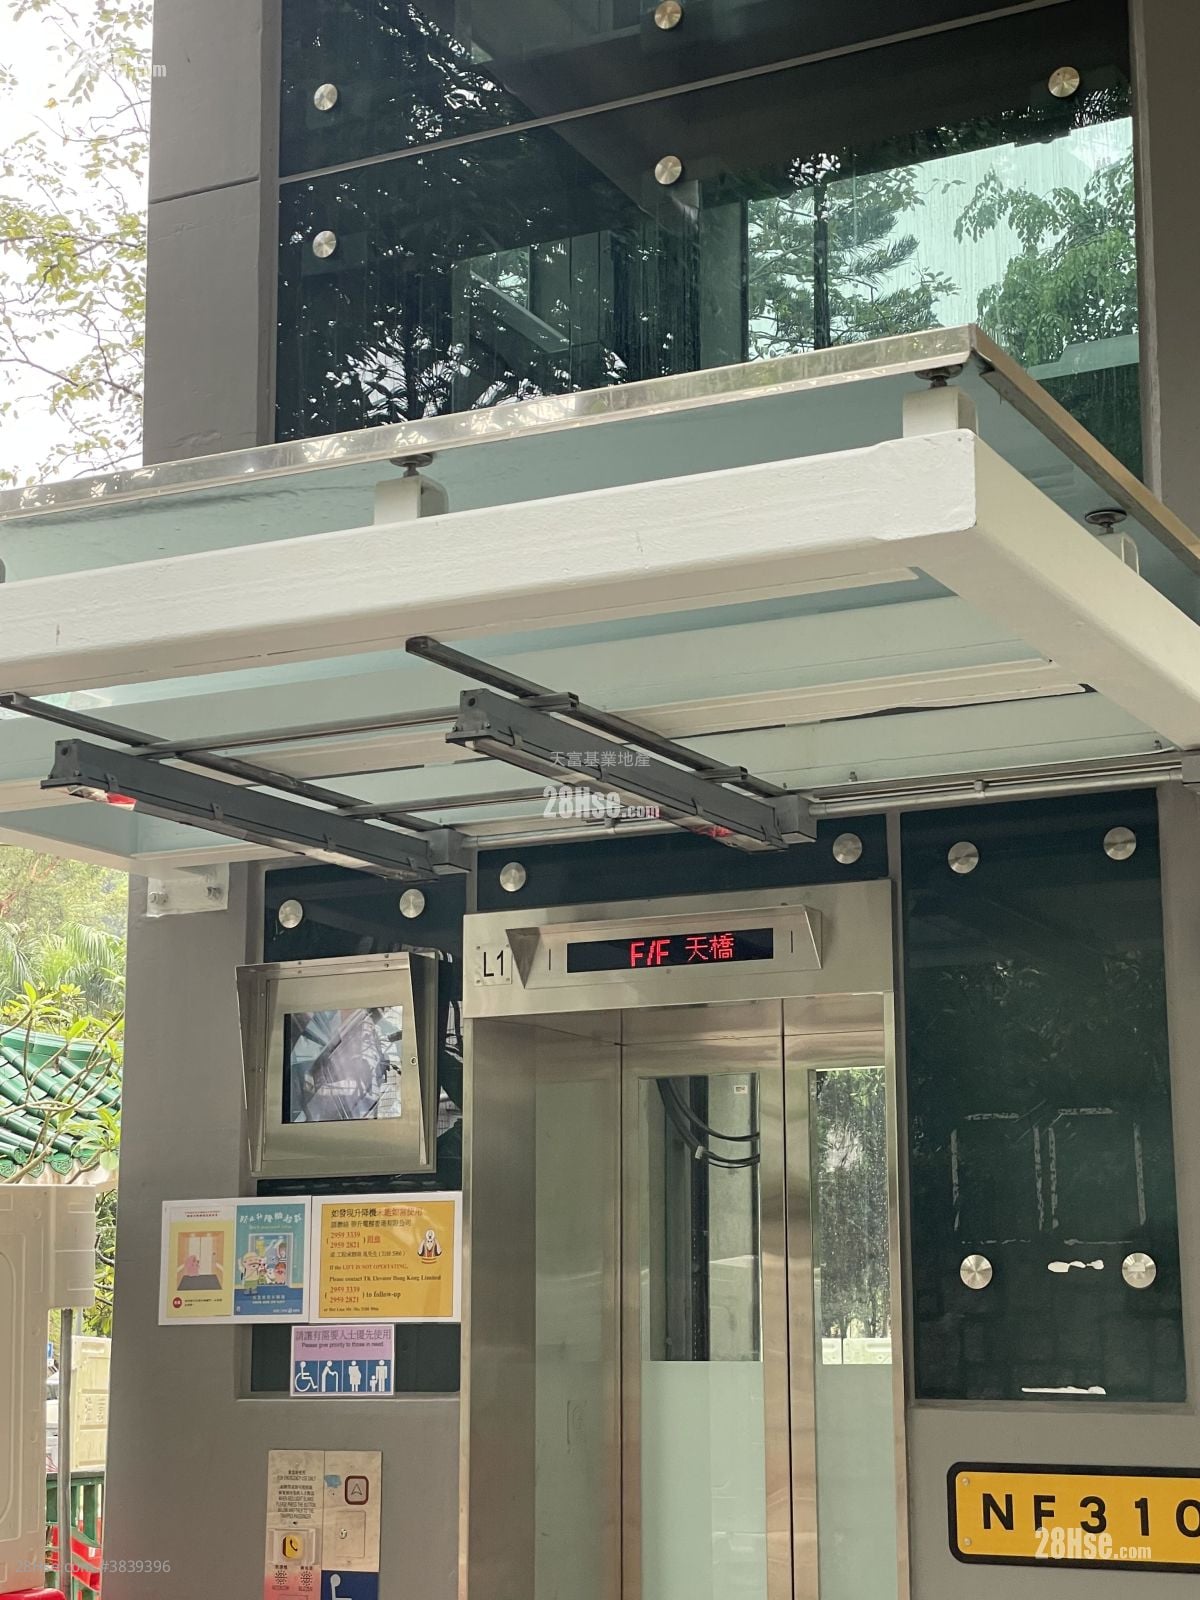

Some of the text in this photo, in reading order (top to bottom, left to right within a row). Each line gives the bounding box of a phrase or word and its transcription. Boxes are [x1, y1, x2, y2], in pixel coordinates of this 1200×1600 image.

[630, 932, 735, 967] F/F 天橋
[483, 949, 505, 978] L1
[374, 1291, 401, 1299] follow-up
[295, 1329, 392, 1341] 請讓有需要人士優先使用
